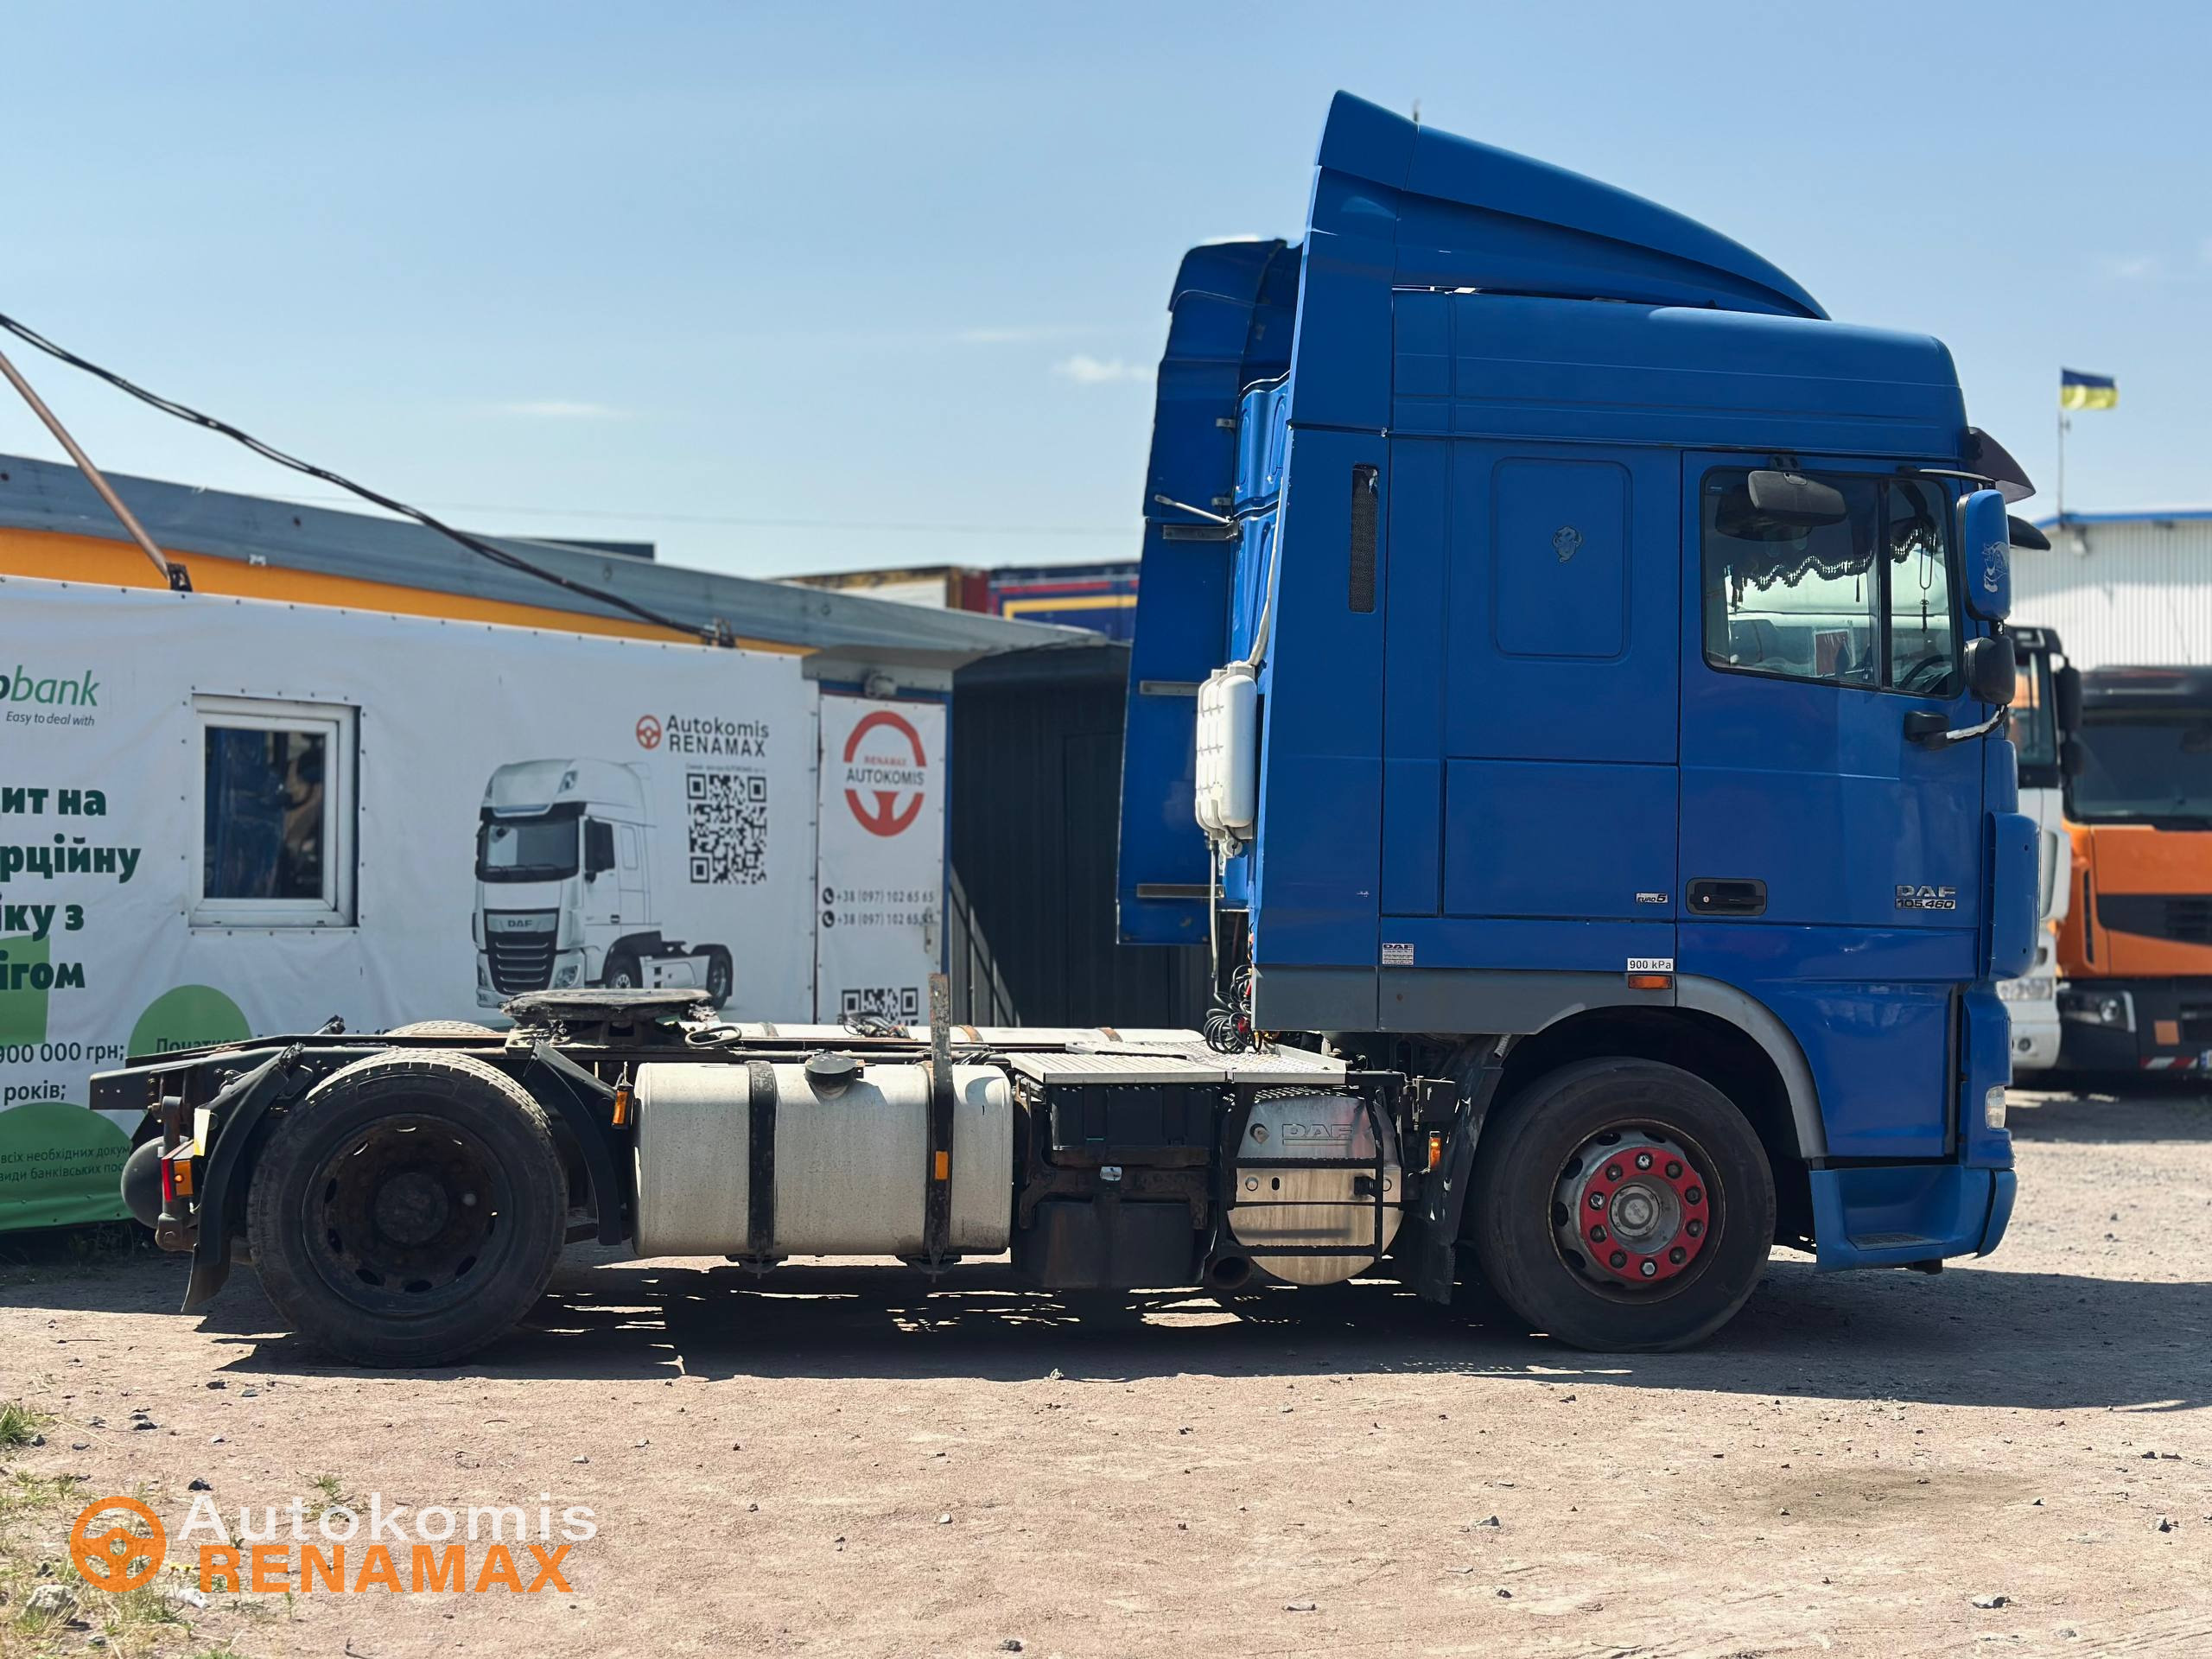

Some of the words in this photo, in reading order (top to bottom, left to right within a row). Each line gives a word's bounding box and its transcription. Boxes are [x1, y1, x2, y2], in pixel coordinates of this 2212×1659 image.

[6, 711, 32, 726] Easy
[35, 714, 45, 724] to
[47, 714, 71, 725] deal
[73, 715, 95, 727] with
[666, 715, 769, 738] Autokomis
[669, 734, 766, 757] RENAMAX
[846, 767, 925, 785] AUTOKOMIS
[2, 787, 48, 814] ит
[58, 788, 106, 816] на
[0, 833, 141, 883] рційну
[1896, 885, 1956, 898] DAF
[1897, 899, 1955, 909] 105.460
[0, 892, 56, 942] ку
[65, 905, 84, 931] з
[1630, 960, 1649, 969] 900
[1651, 960, 1672, 969] kPa
[40, 1042, 81, 1062] 000
[86, 1045, 124, 1065] грн;
[4, 1079, 67, 1106] років;
[1282, 1123, 1352, 1139] DAF
[1, 1151, 23, 1164] всіх
[26, 1147, 94, 1161] необхідних
[30, 1164, 103, 1180] банківських
